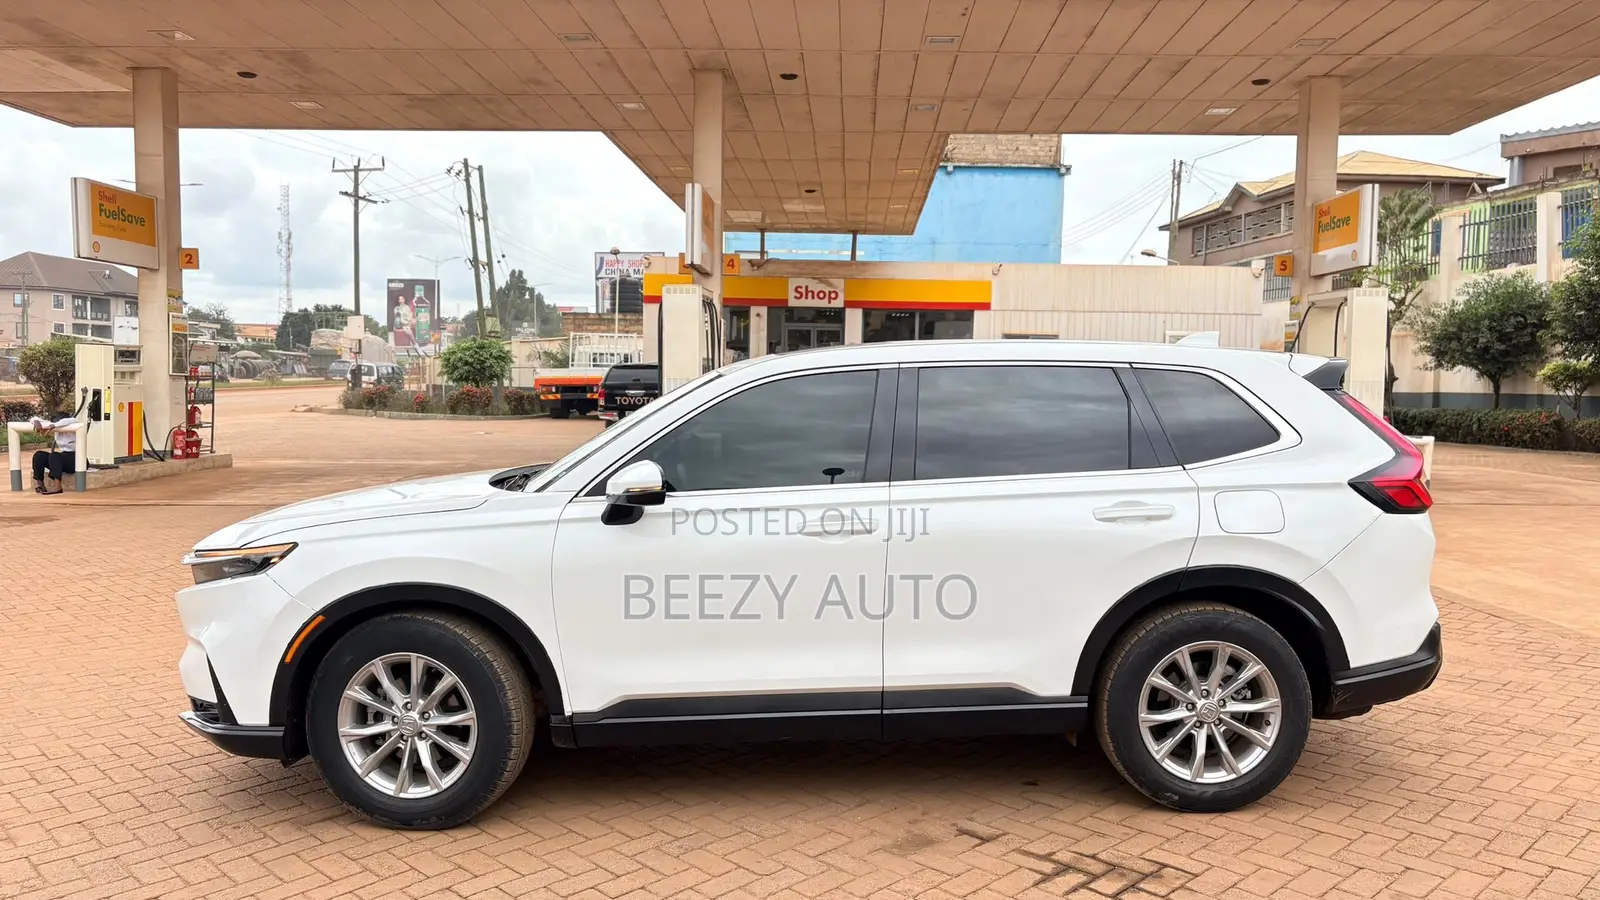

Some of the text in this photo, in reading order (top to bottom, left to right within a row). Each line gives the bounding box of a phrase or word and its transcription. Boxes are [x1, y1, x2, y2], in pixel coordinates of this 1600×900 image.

[98, 190, 117, 204] Shell
[98, 203, 146, 227] FuelSave
[1318, 206, 1331, 219] Shell
[1318, 215, 1351, 234] FuelSave
[184, 253, 194, 264] 2
[605, 259, 624, 268] HAPPY
[726, 258, 736, 269] 4
[1279, 260, 1288, 271] 5
[605, 268, 631, 276] CHINA
[793, 285, 839, 304] Shop
